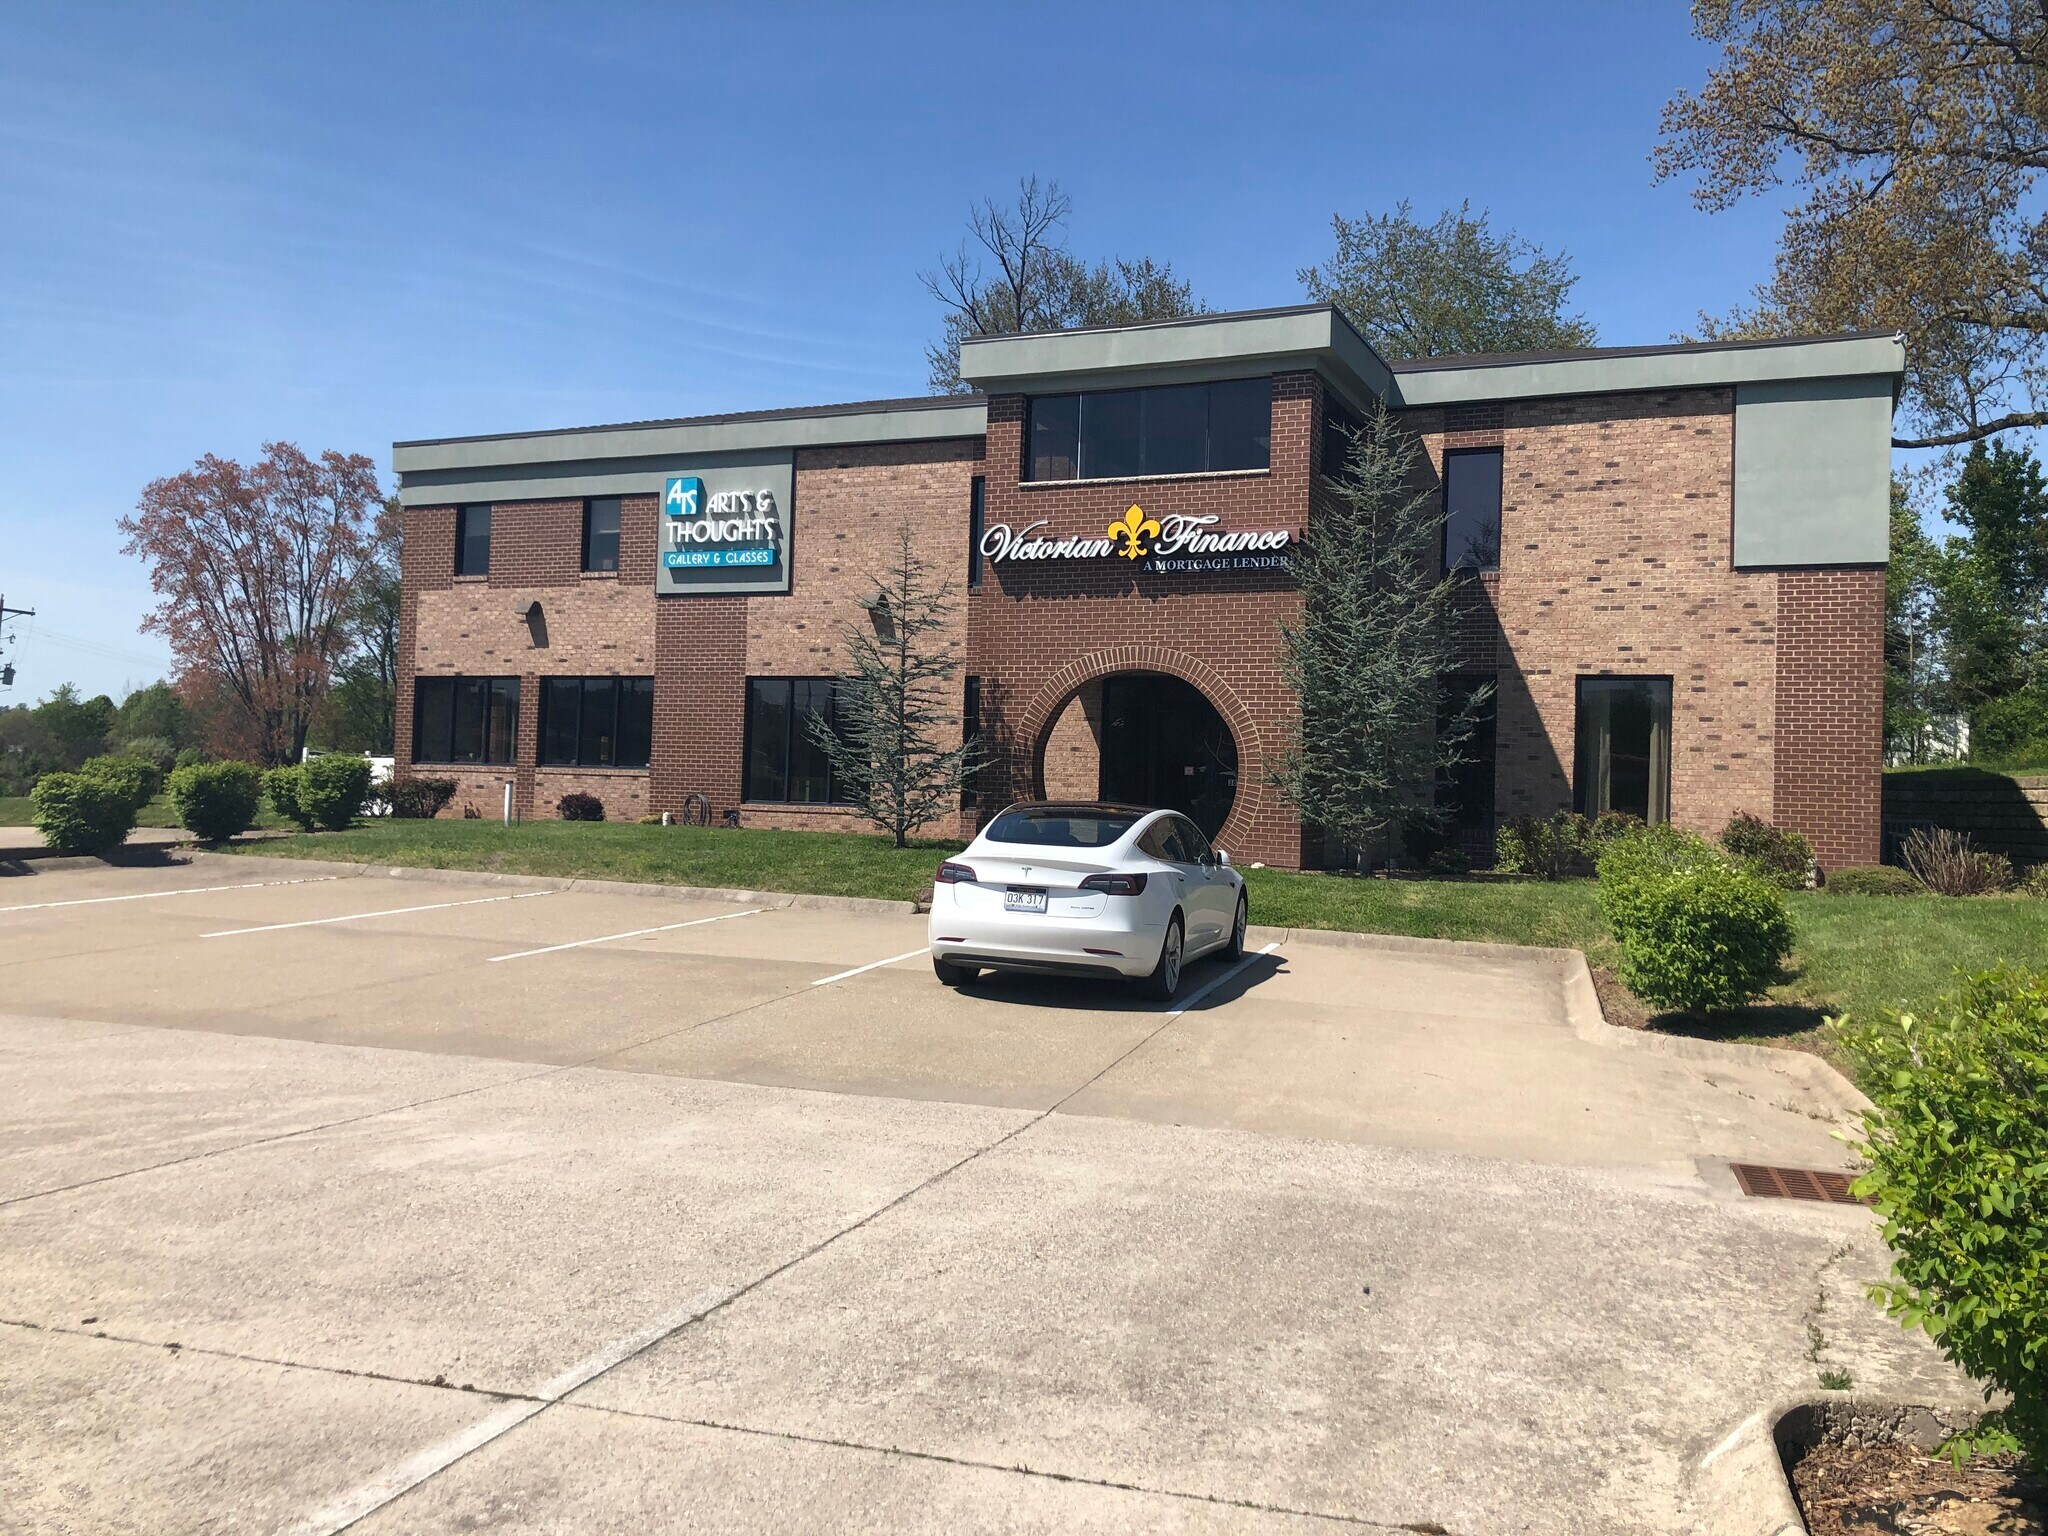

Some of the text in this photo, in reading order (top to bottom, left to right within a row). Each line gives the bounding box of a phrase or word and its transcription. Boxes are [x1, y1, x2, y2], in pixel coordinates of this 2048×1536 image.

[705, 489, 773, 513] ARTS &
[665, 518, 776, 543] THOUGHTS
[979, 514, 1289, 563] Victorian Finance
[668, 551, 769, 565] GALLERY & CLASSES
[1143, 556, 1289, 571] A MORTGAGE LENDER
[1027, 893, 1044, 905] 317
